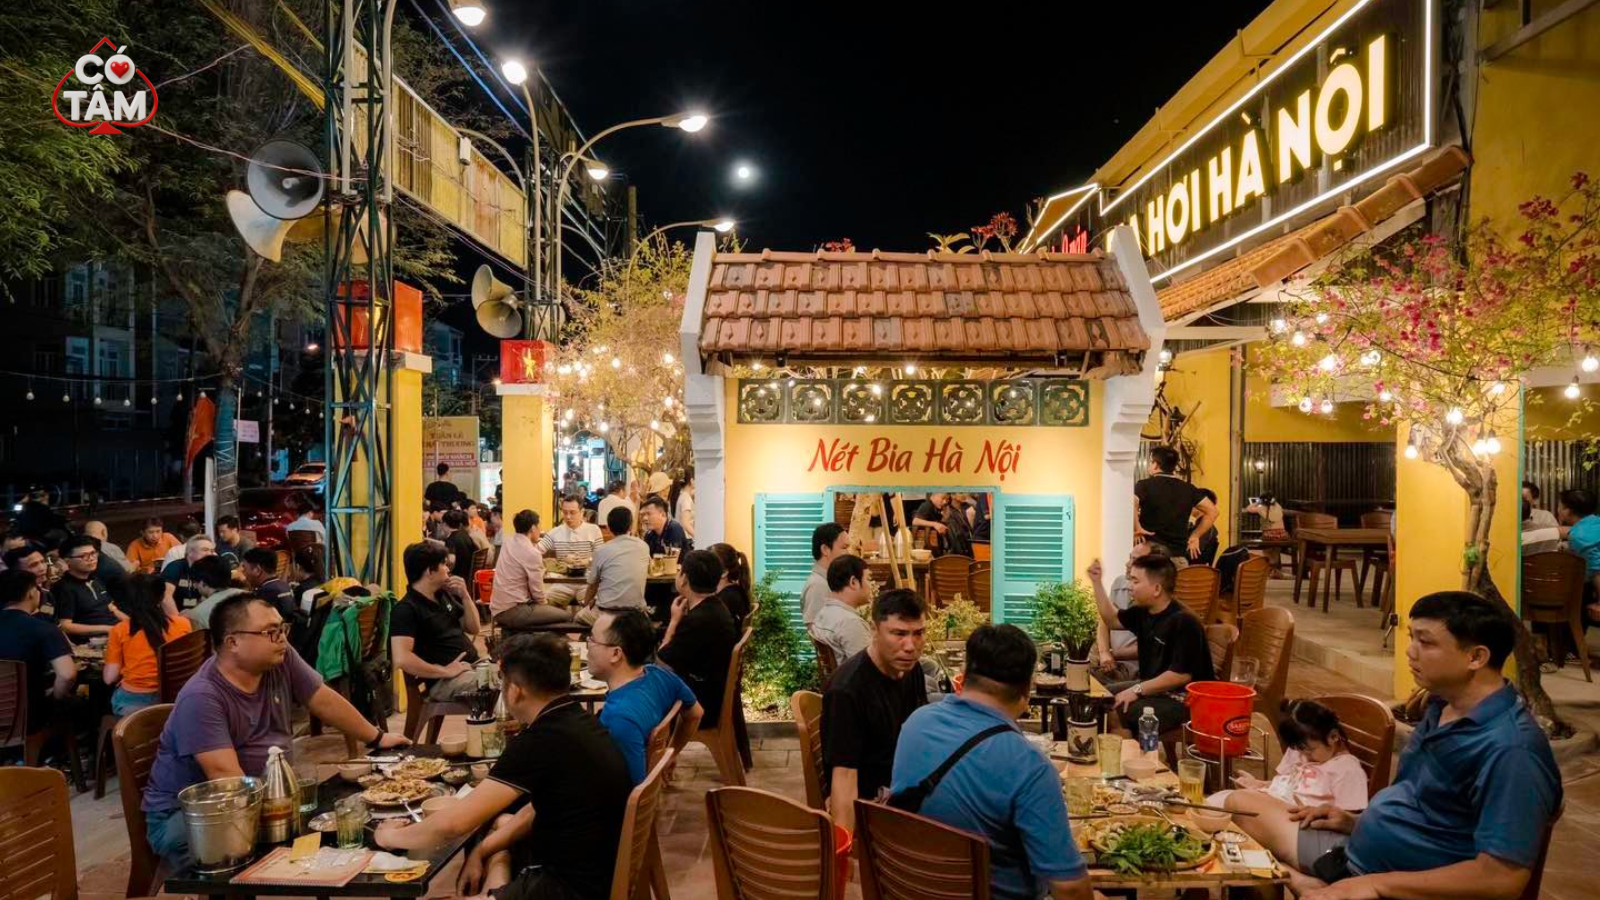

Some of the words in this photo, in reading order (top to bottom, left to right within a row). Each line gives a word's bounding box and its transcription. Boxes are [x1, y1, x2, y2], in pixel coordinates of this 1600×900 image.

[1148, 168, 1200, 256] HƠI
[1208, 112, 1265, 223] HÀ
[1278, 34, 1386, 184] NỘI
[807, 437, 860, 473] Nét
[866, 437, 914, 473] Bia
[923, 436, 964, 473] Hà
[973, 439, 1022, 482] Nội
